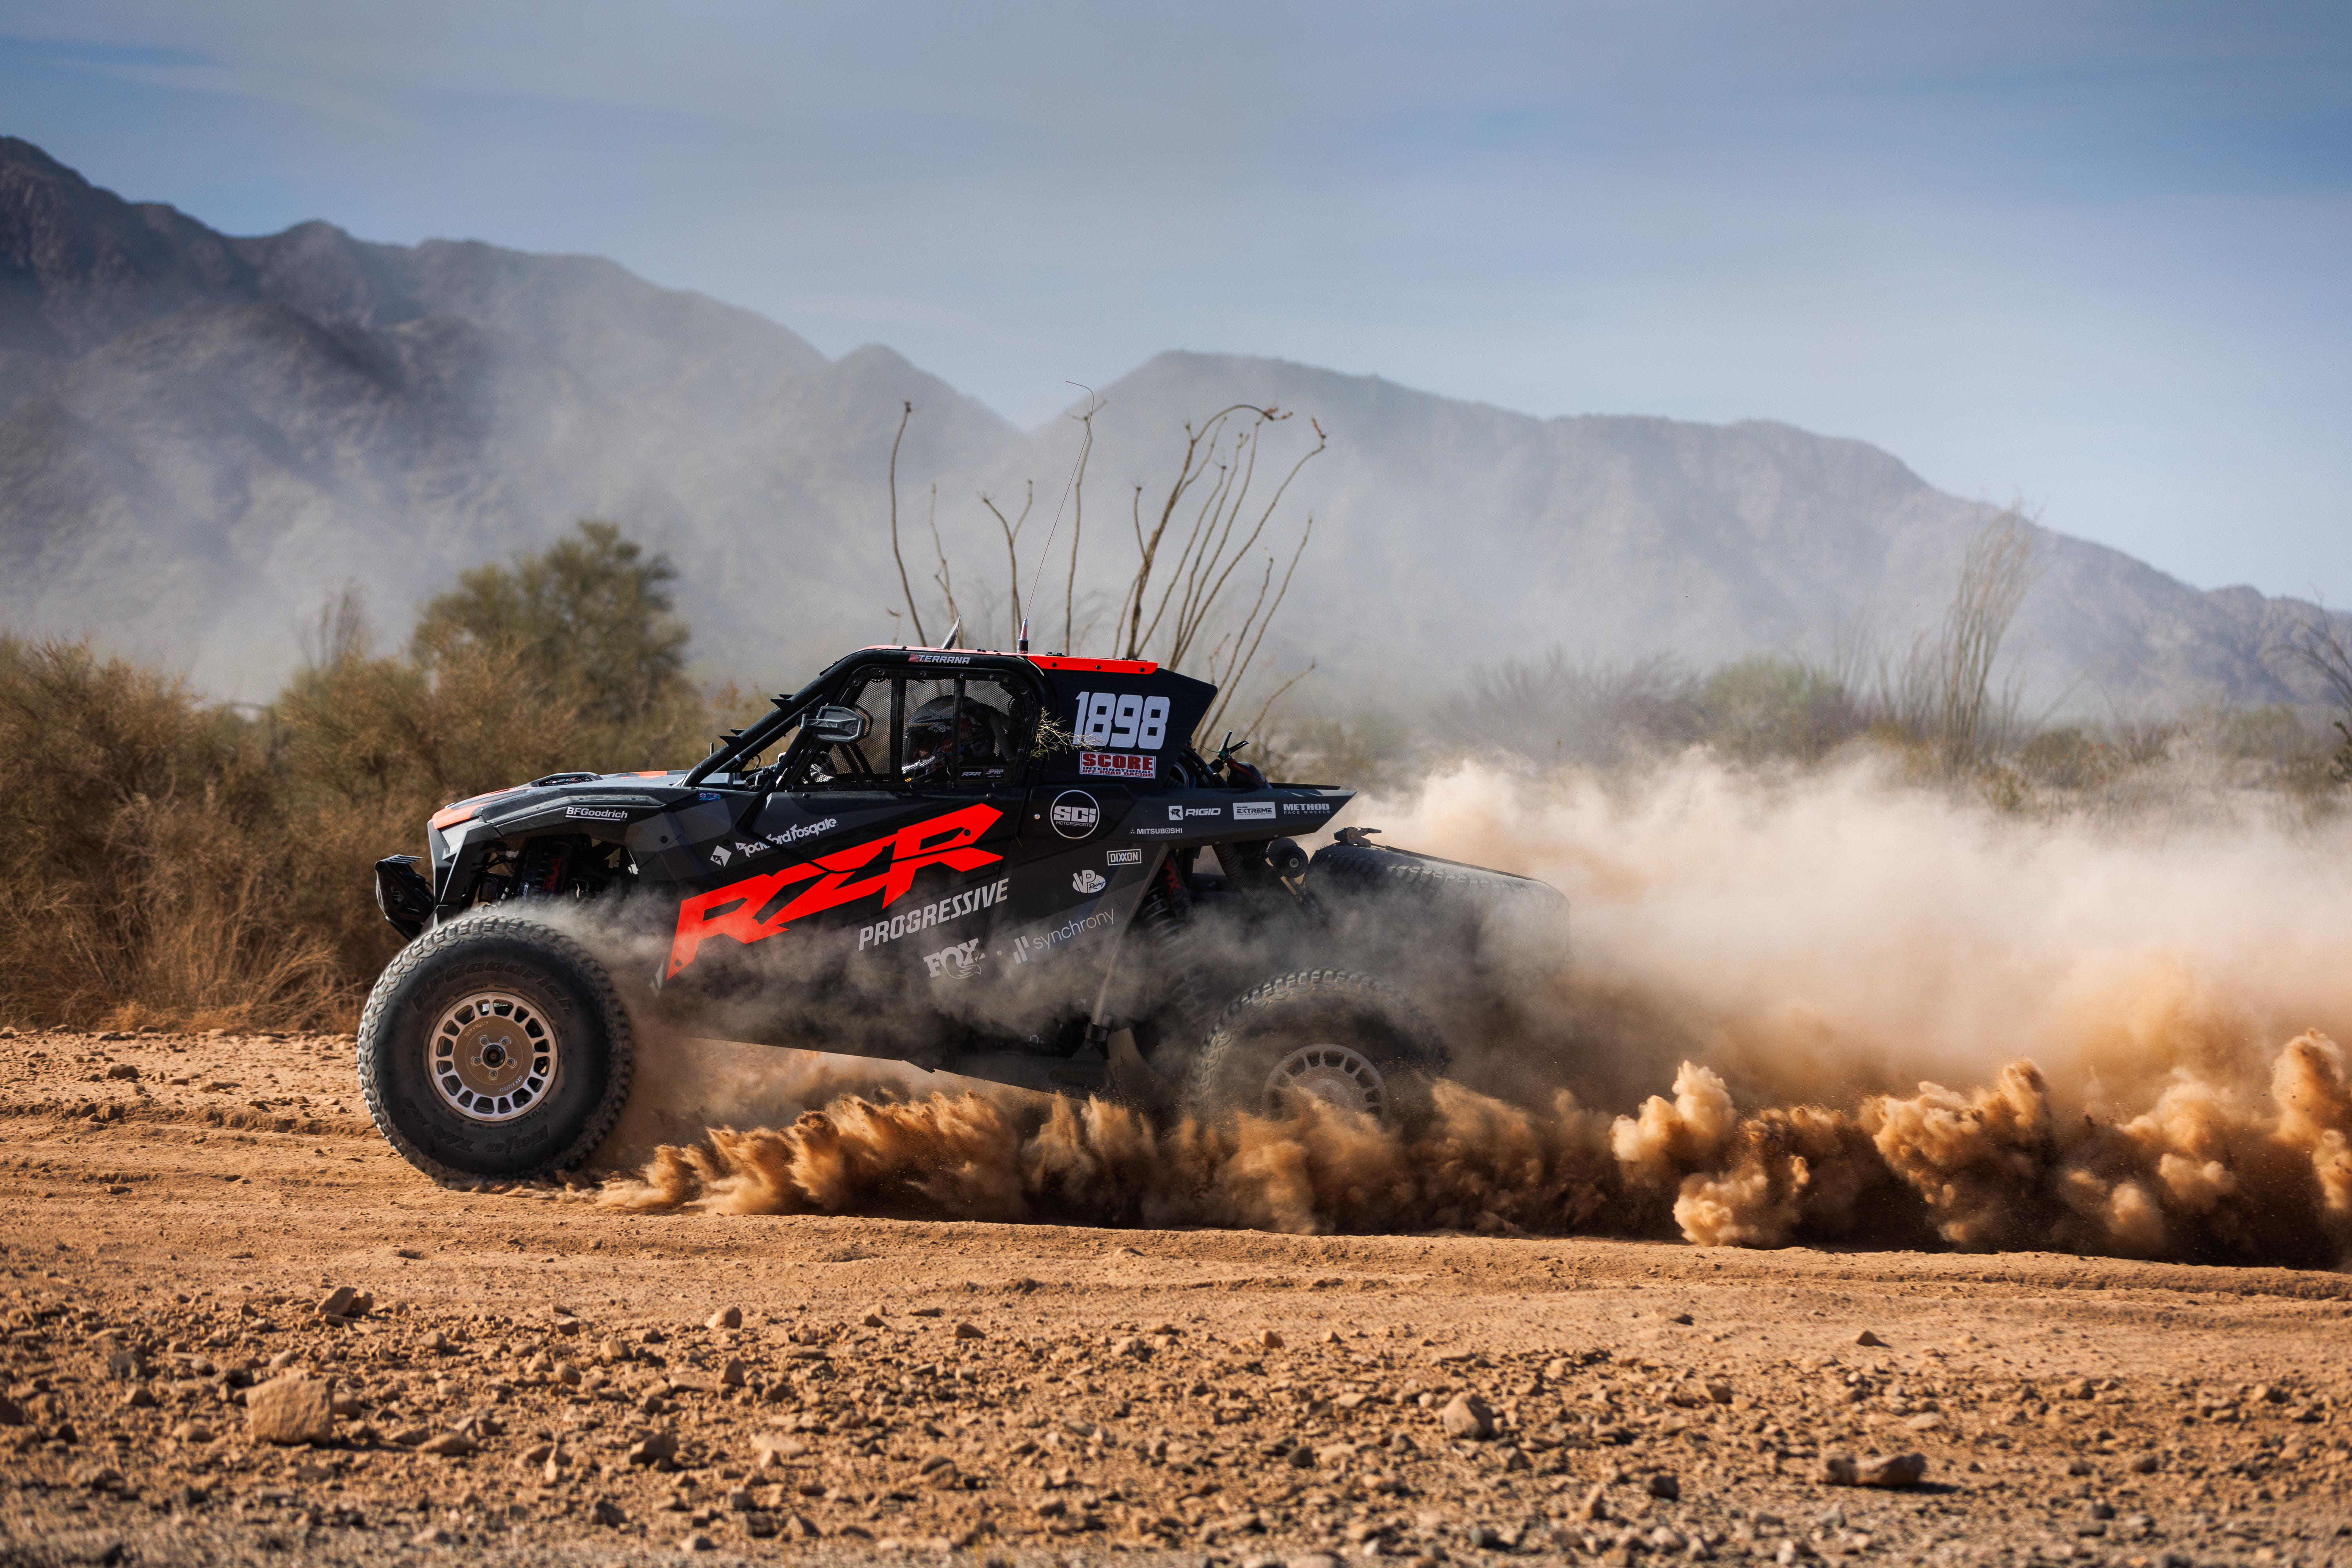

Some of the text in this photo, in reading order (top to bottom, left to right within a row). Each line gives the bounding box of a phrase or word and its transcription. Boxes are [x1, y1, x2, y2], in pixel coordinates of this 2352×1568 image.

[918, 655, 971, 664] TERRANA
[1073, 691, 1170, 750] 1898
[1082, 753, 1153, 771] SCORE
[566, 807, 628, 818] BFGoodrich
[1185, 808, 1221, 816] RIGID
[1110, 852, 1138, 862] DIXXON
[666, 803, 1003, 981] RZR
[1073, 870, 1096, 893] VP
[1089, 881, 1106, 891] Racing
[858, 878, 1009, 951] PROGRESSIVE
[1033, 908, 1114, 949] synchrony
[923, 938, 986, 978] FOX
[412, 961, 575, 1014] BFGoodrich
[486, 1124, 550, 1154] Baja
